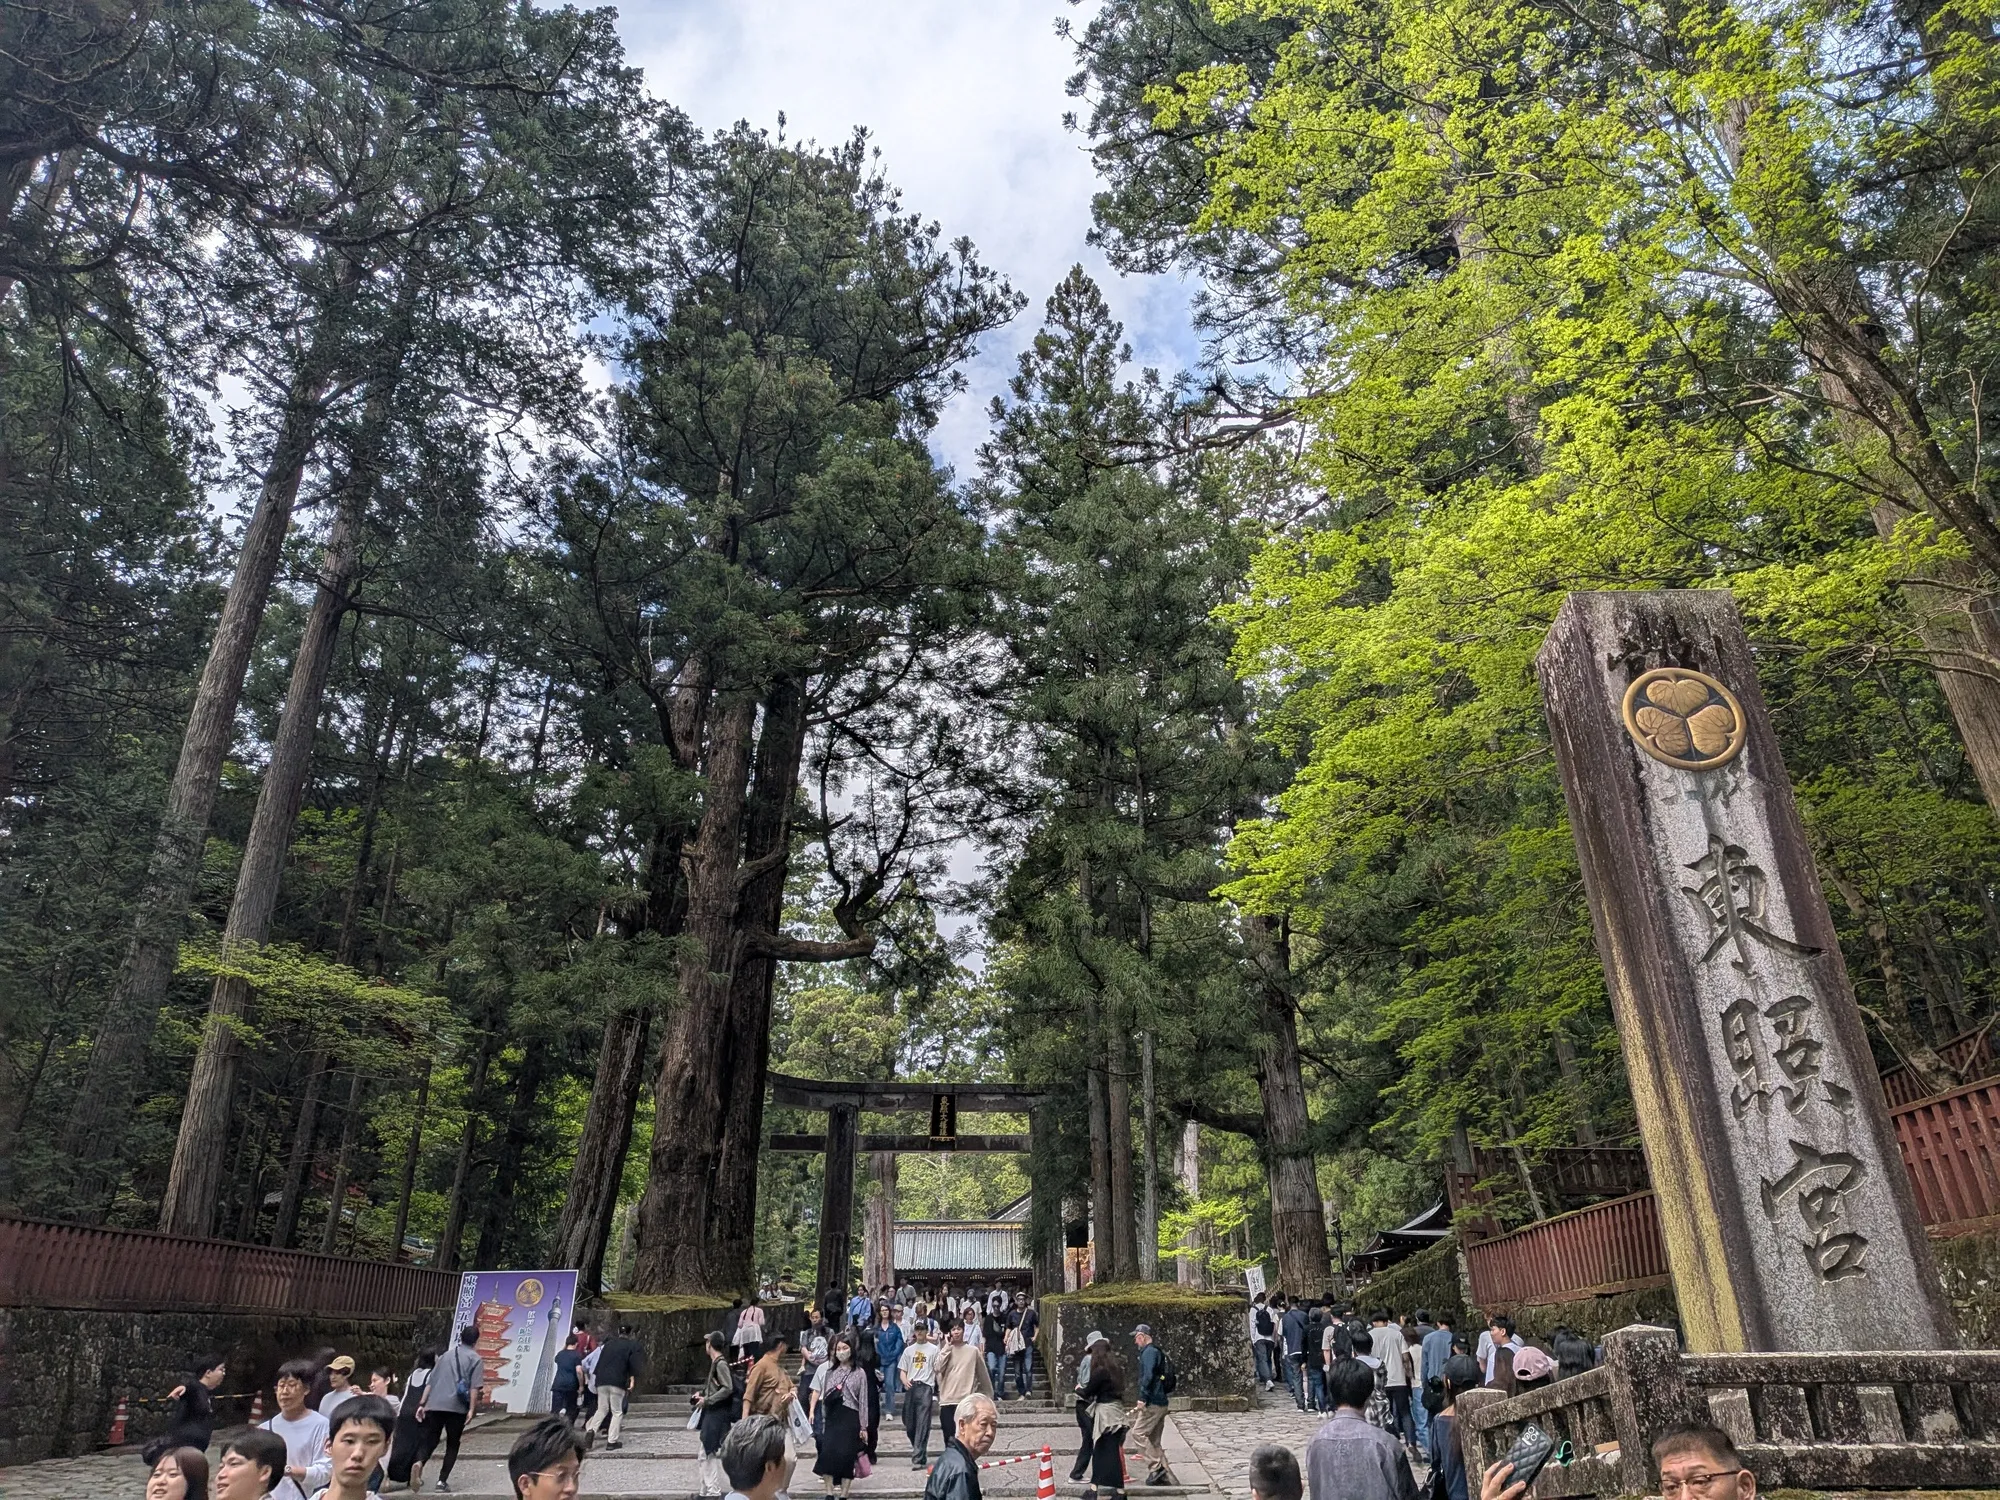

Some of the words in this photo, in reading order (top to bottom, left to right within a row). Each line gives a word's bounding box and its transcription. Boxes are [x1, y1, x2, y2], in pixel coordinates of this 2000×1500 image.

[1682, 834, 1869, 1284] 東照宮
[460, 1275, 478, 1308] 東照宮
[511, 1327, 525, 1387] 新たなつながり
